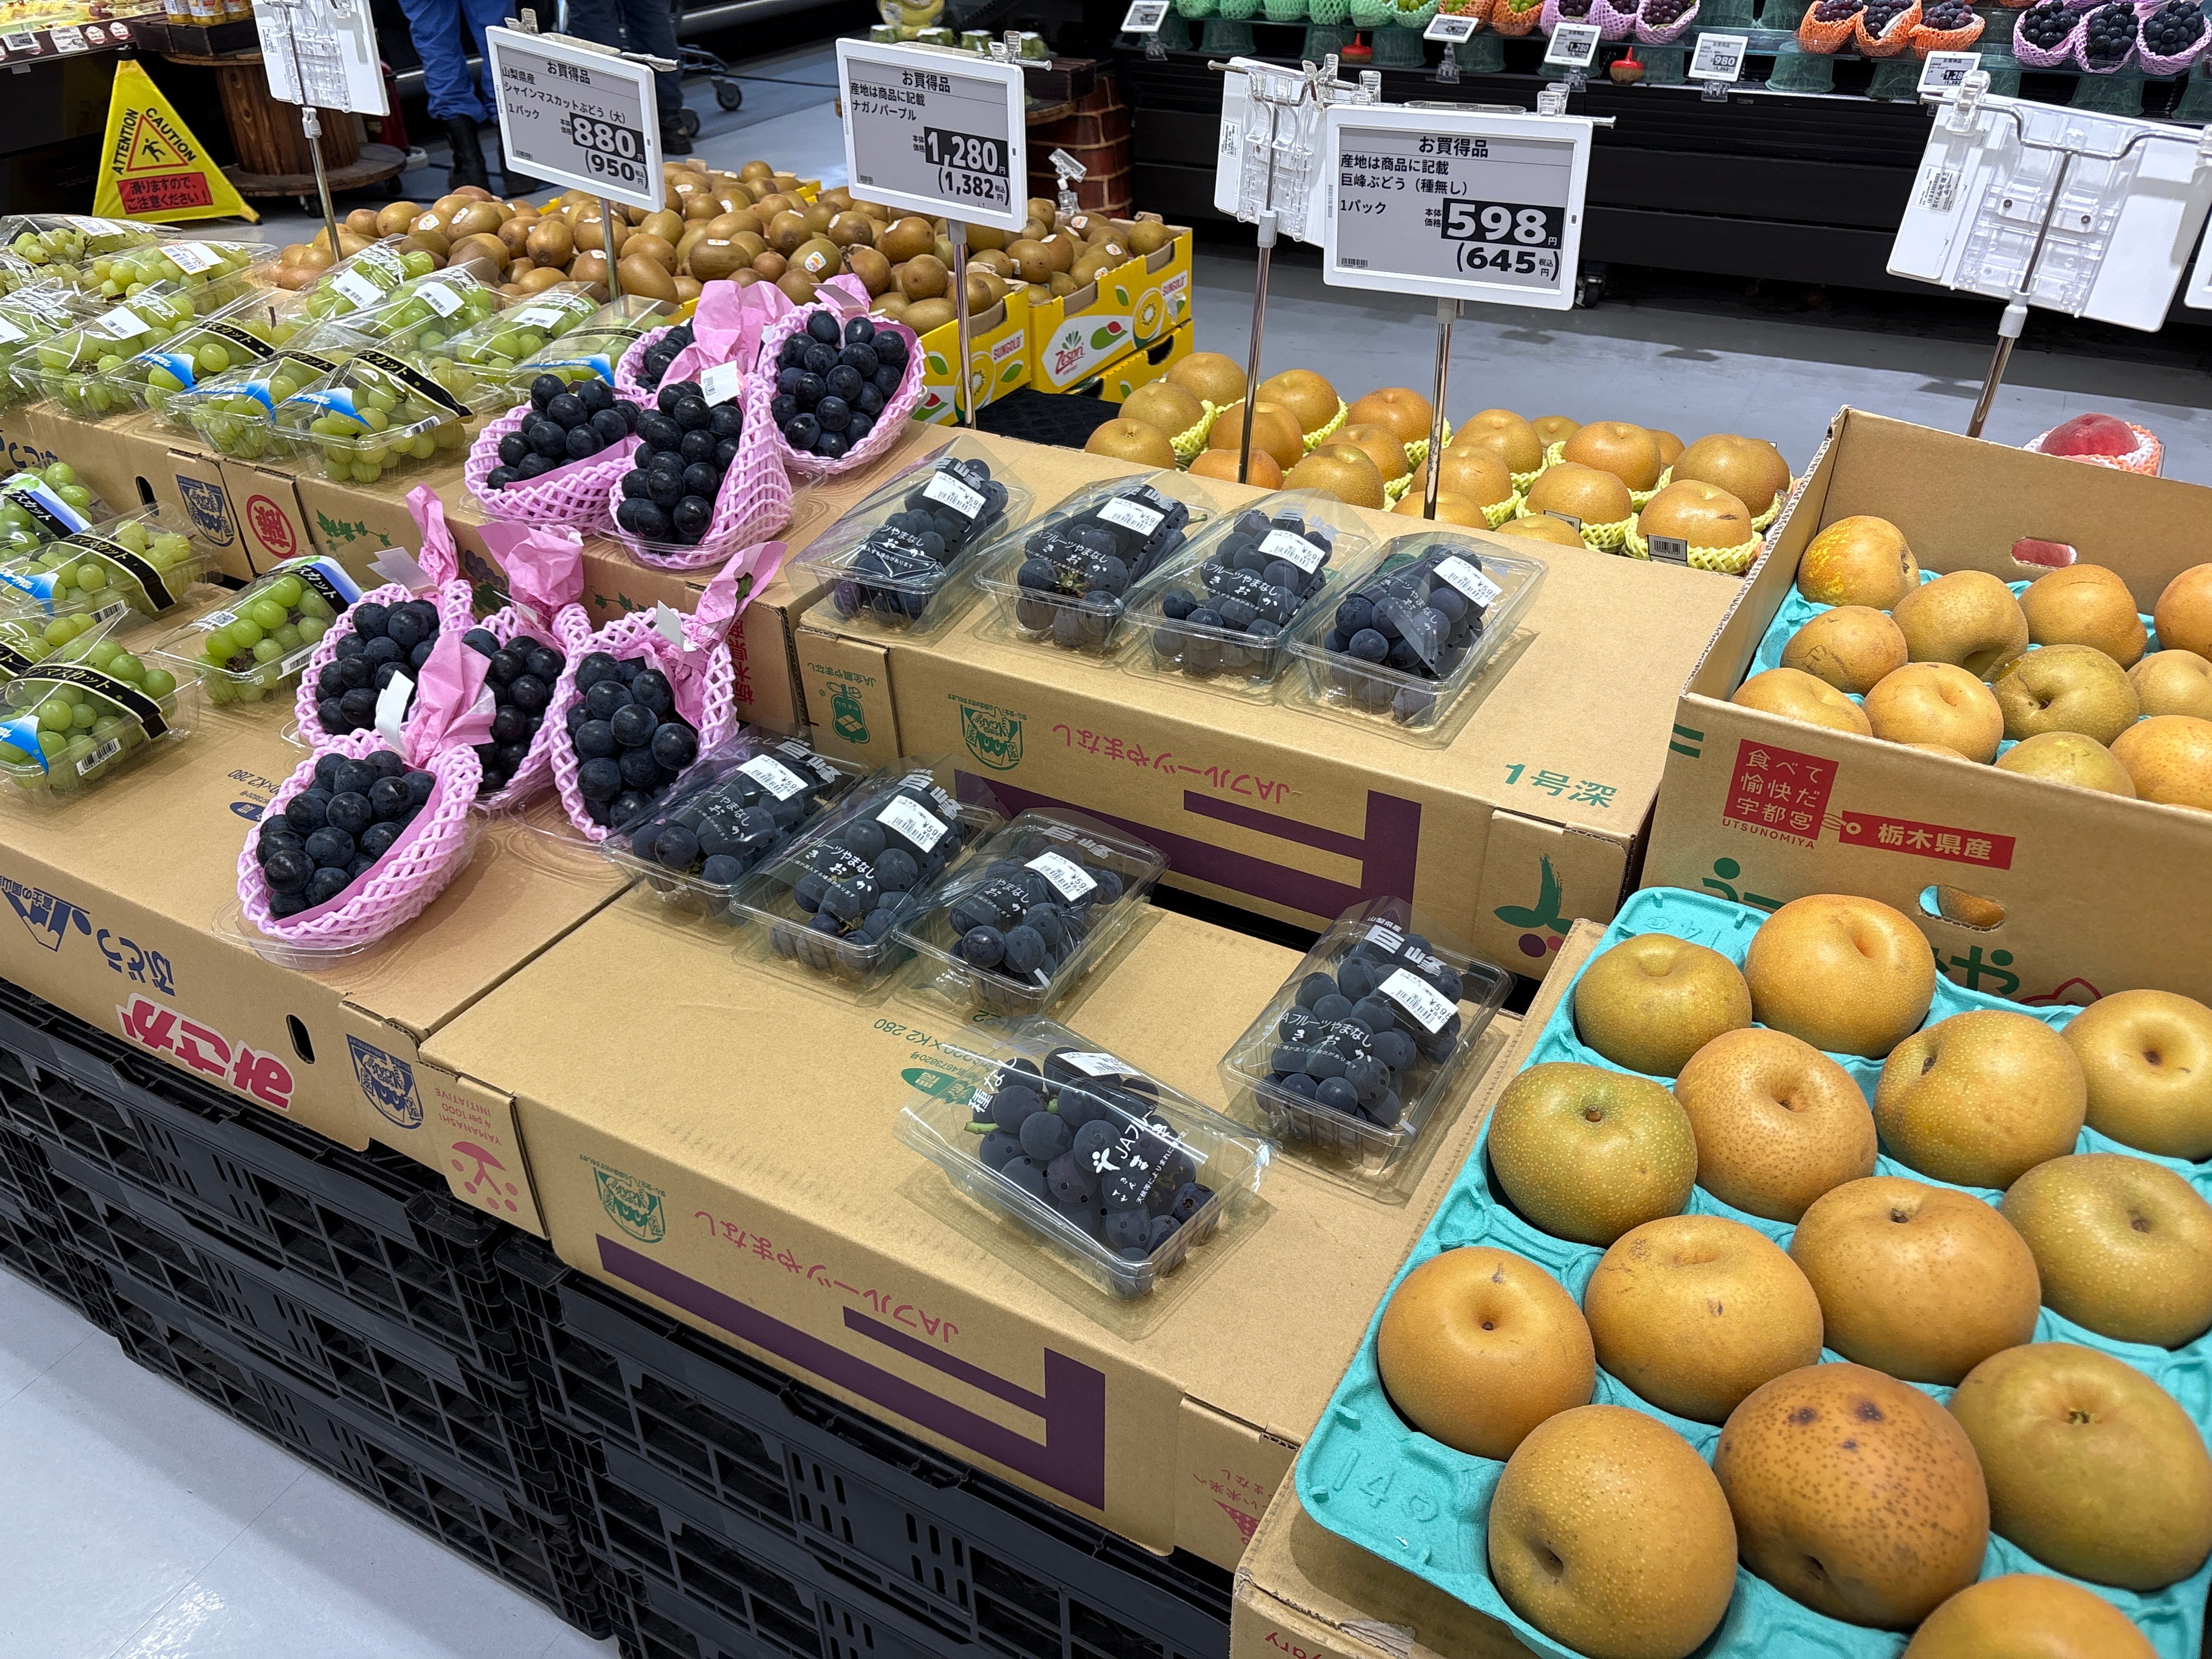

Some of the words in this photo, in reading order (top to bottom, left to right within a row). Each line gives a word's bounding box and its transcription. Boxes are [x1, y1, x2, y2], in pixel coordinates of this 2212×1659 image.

[547, 61, 591, 84] お買得品
[1715, 56, 1735, 66] 980
[501, 66, 535, 84] 山梨県産
[902, 71, 951, 93] お買得品
[1945, 71, 1963, 80] 1,28
[850, 82, 926, 106] 産地は商品に記載
[509, 103, 540, 119] 1パック
[852, 101, 917, 121] ナガノパープル
[111, 108, 139, 176] ATTENTION
[145, 108, 197, 162] CAUTION
[573, 117, 636, 158] 880
[1419, 136, 1489, 158] お買得品
[927, 131, 998, 173] 1,280
[1340, 154, 1449, 175] 産地は商品に記載
[1340, 199, 1387, 215] 1パック
[1425, 208, 1442, 218] 本体
[1424, 218, 1441, 228] 価格
[1447, 202, 1547, 245] 598
[1163, 275, 1186, 297] SUNGOLD
[993, 335, 1022, 360] SUNGOLD
[808, 663, 876, 687] JA全農やまなし
[1052, 724, 1290, 805] JAフルーツやまなし
[1745, 749, 1824, 785] 食べて
[1505, 763, 1618, 808] 1号深
[1740, 772, 1822, 808] 愉快だ
[1736, 797, 1814, 832] 宇都宮
[922, 822, 944, 840] ¥598
[1722, 817, 1816, 850] UTSUNOMIYA
[1877, 823, 1992, 861] 栃木県産
[1367, 915, 1402, 933] 山梨県産
[96, 928, 176, 997] ぶどう
[1429, 997, 1453, 1020] ¥598
[873, 1018, 908, 1037] 280
[120, 999, 292, 1109] みさか
[968, 1056, 1017, 1114] 種なし
[435, 1088, 491, 1116] INITIATIVE
[442, 1103, 467, 1119] 1000
[439, 1113, 502, 1146] YAMANASHI
[469, 1114, 483, 1125] per
[695, 1210, 959, 1344] JAフルーツやまなし
